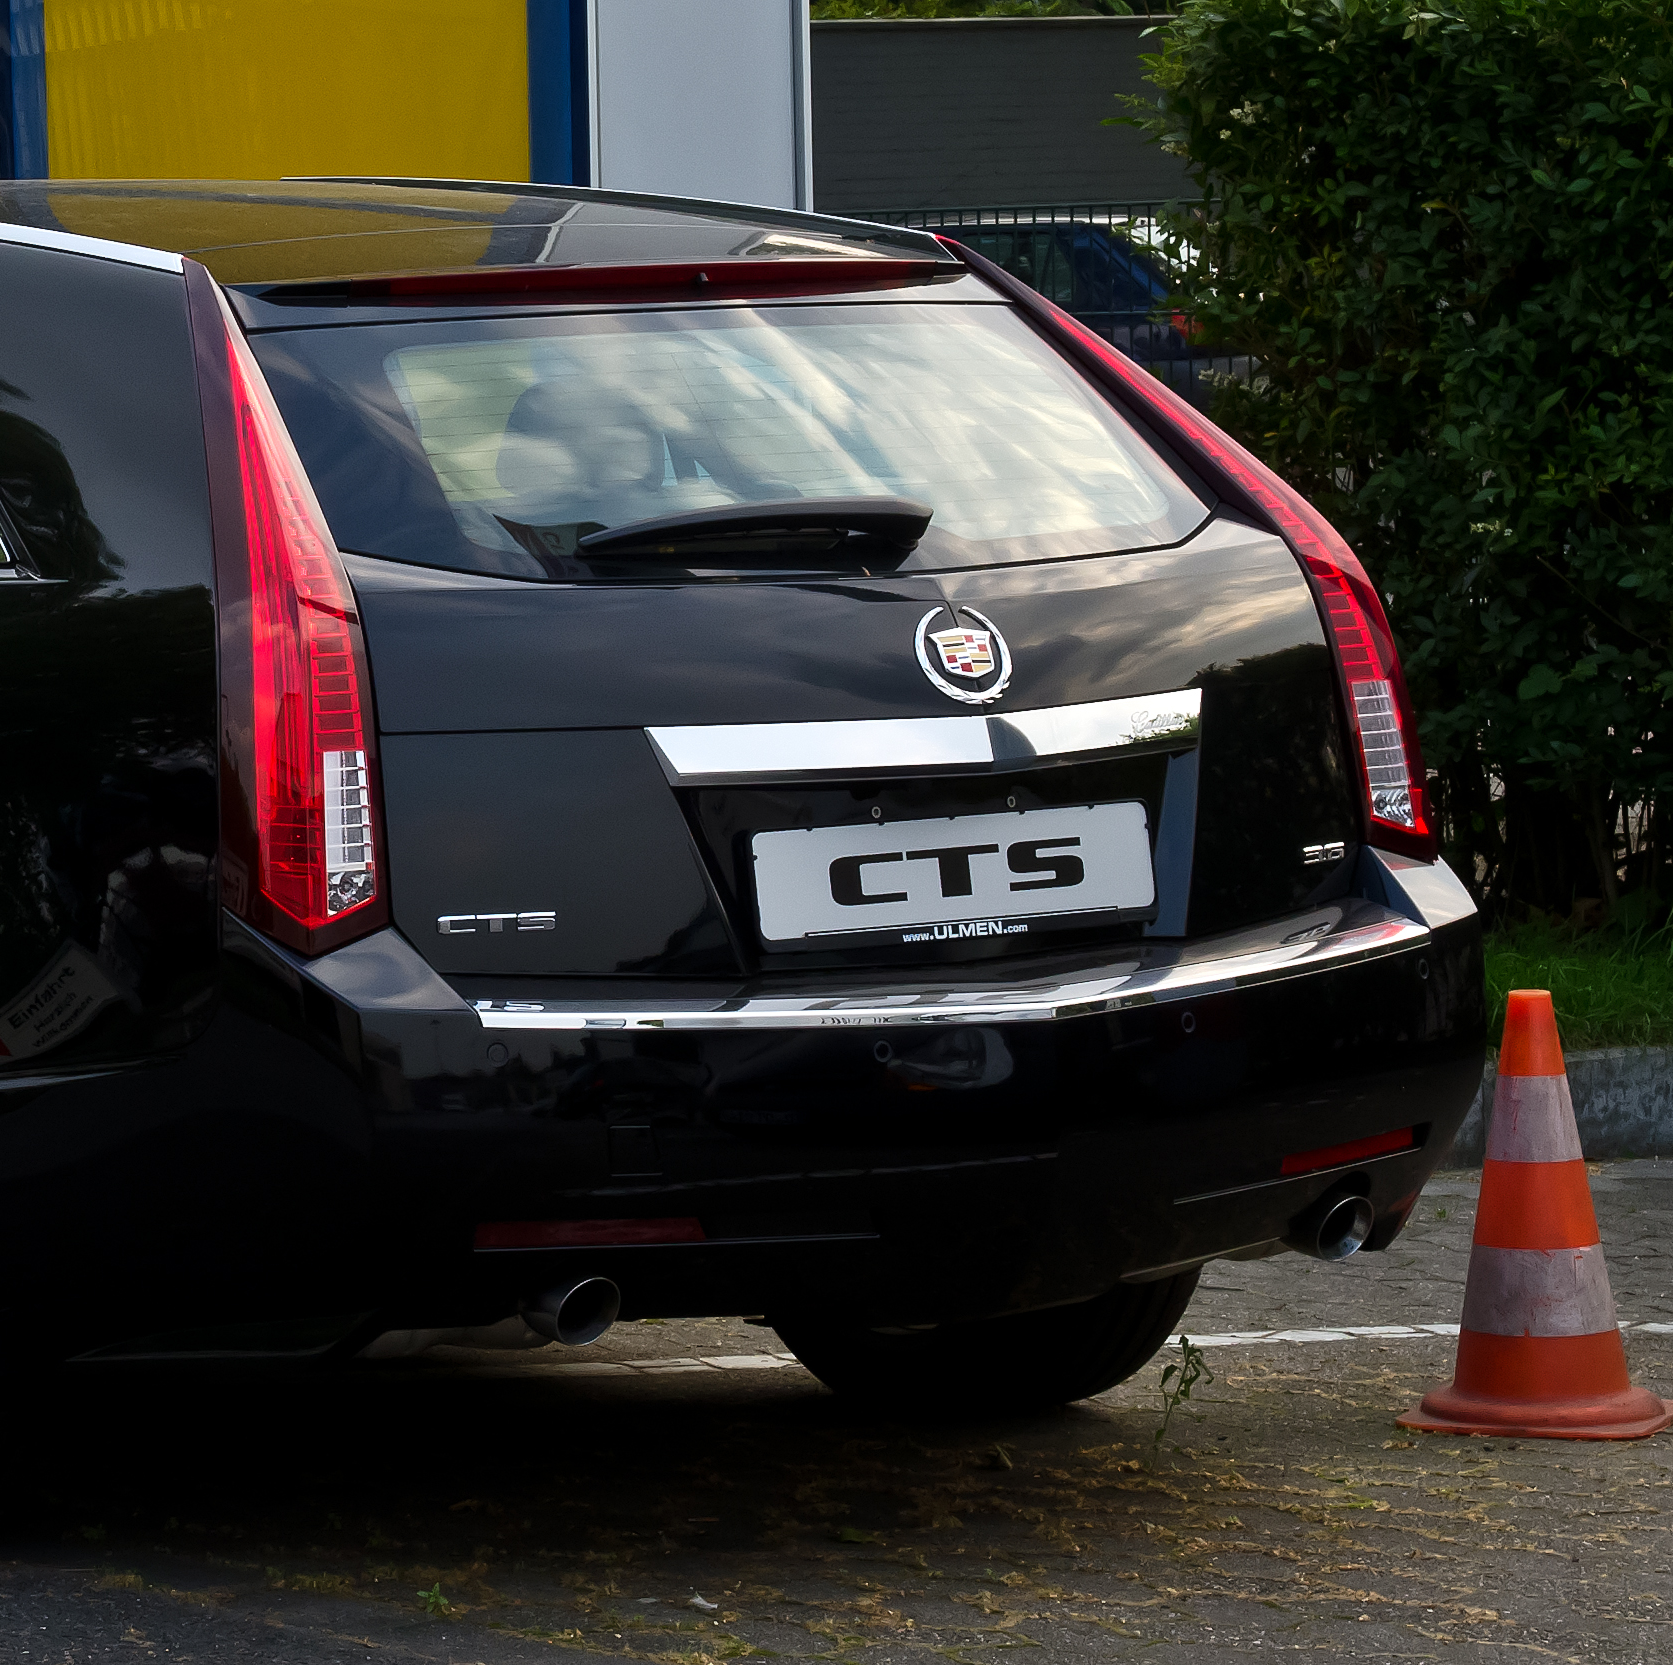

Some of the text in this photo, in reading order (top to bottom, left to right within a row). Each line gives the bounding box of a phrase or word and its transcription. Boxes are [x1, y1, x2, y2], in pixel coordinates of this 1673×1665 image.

[829, 836, 1085, 907] CTS
[436, 911, 556, 935] CTS
[902, 921, 1028, 943] www.ULMEN.com
[7, 966, 75, 1029] Einfahrt
